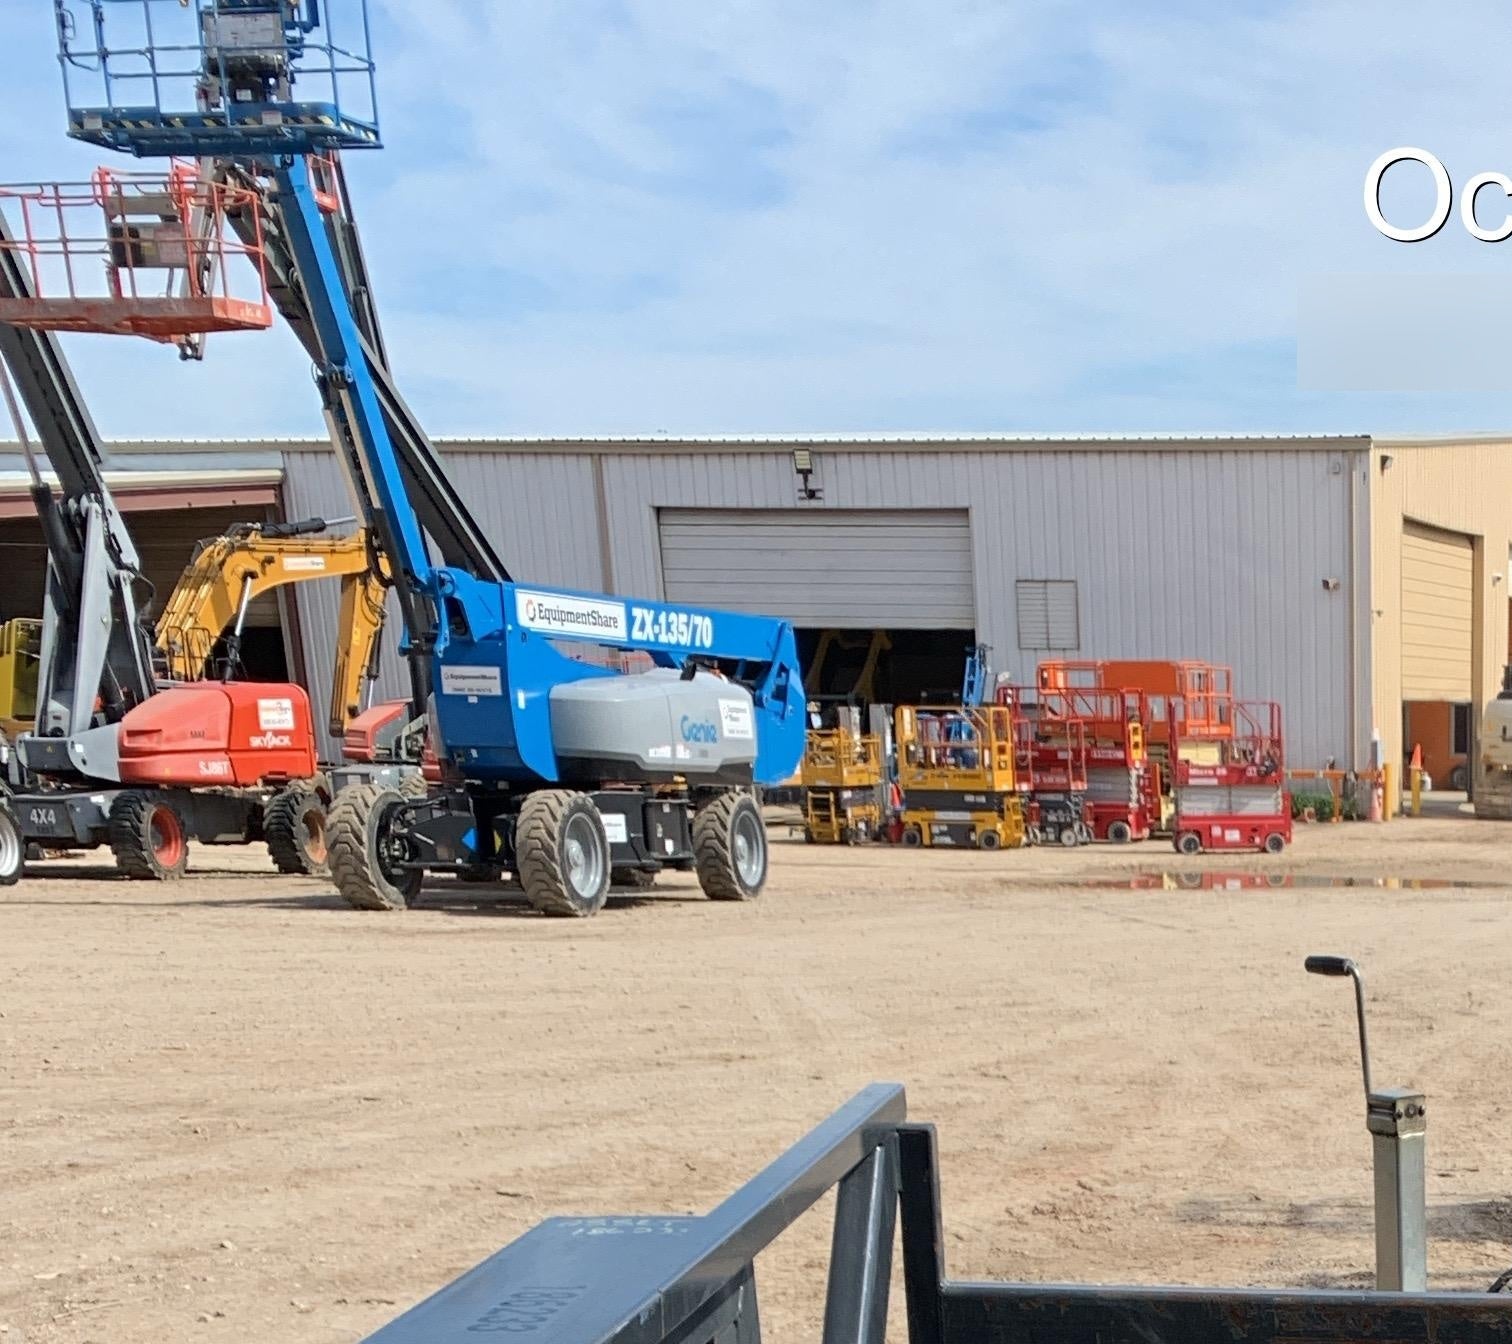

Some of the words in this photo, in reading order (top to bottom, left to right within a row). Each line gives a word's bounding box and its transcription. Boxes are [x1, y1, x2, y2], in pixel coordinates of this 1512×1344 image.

[537, 602, 619, 628] EquipmentShare
[632, 607, 712, 648] ZX-135/70
[680, 715, 717, 744] Genie
[30, 807, 56, 824] 4X4
